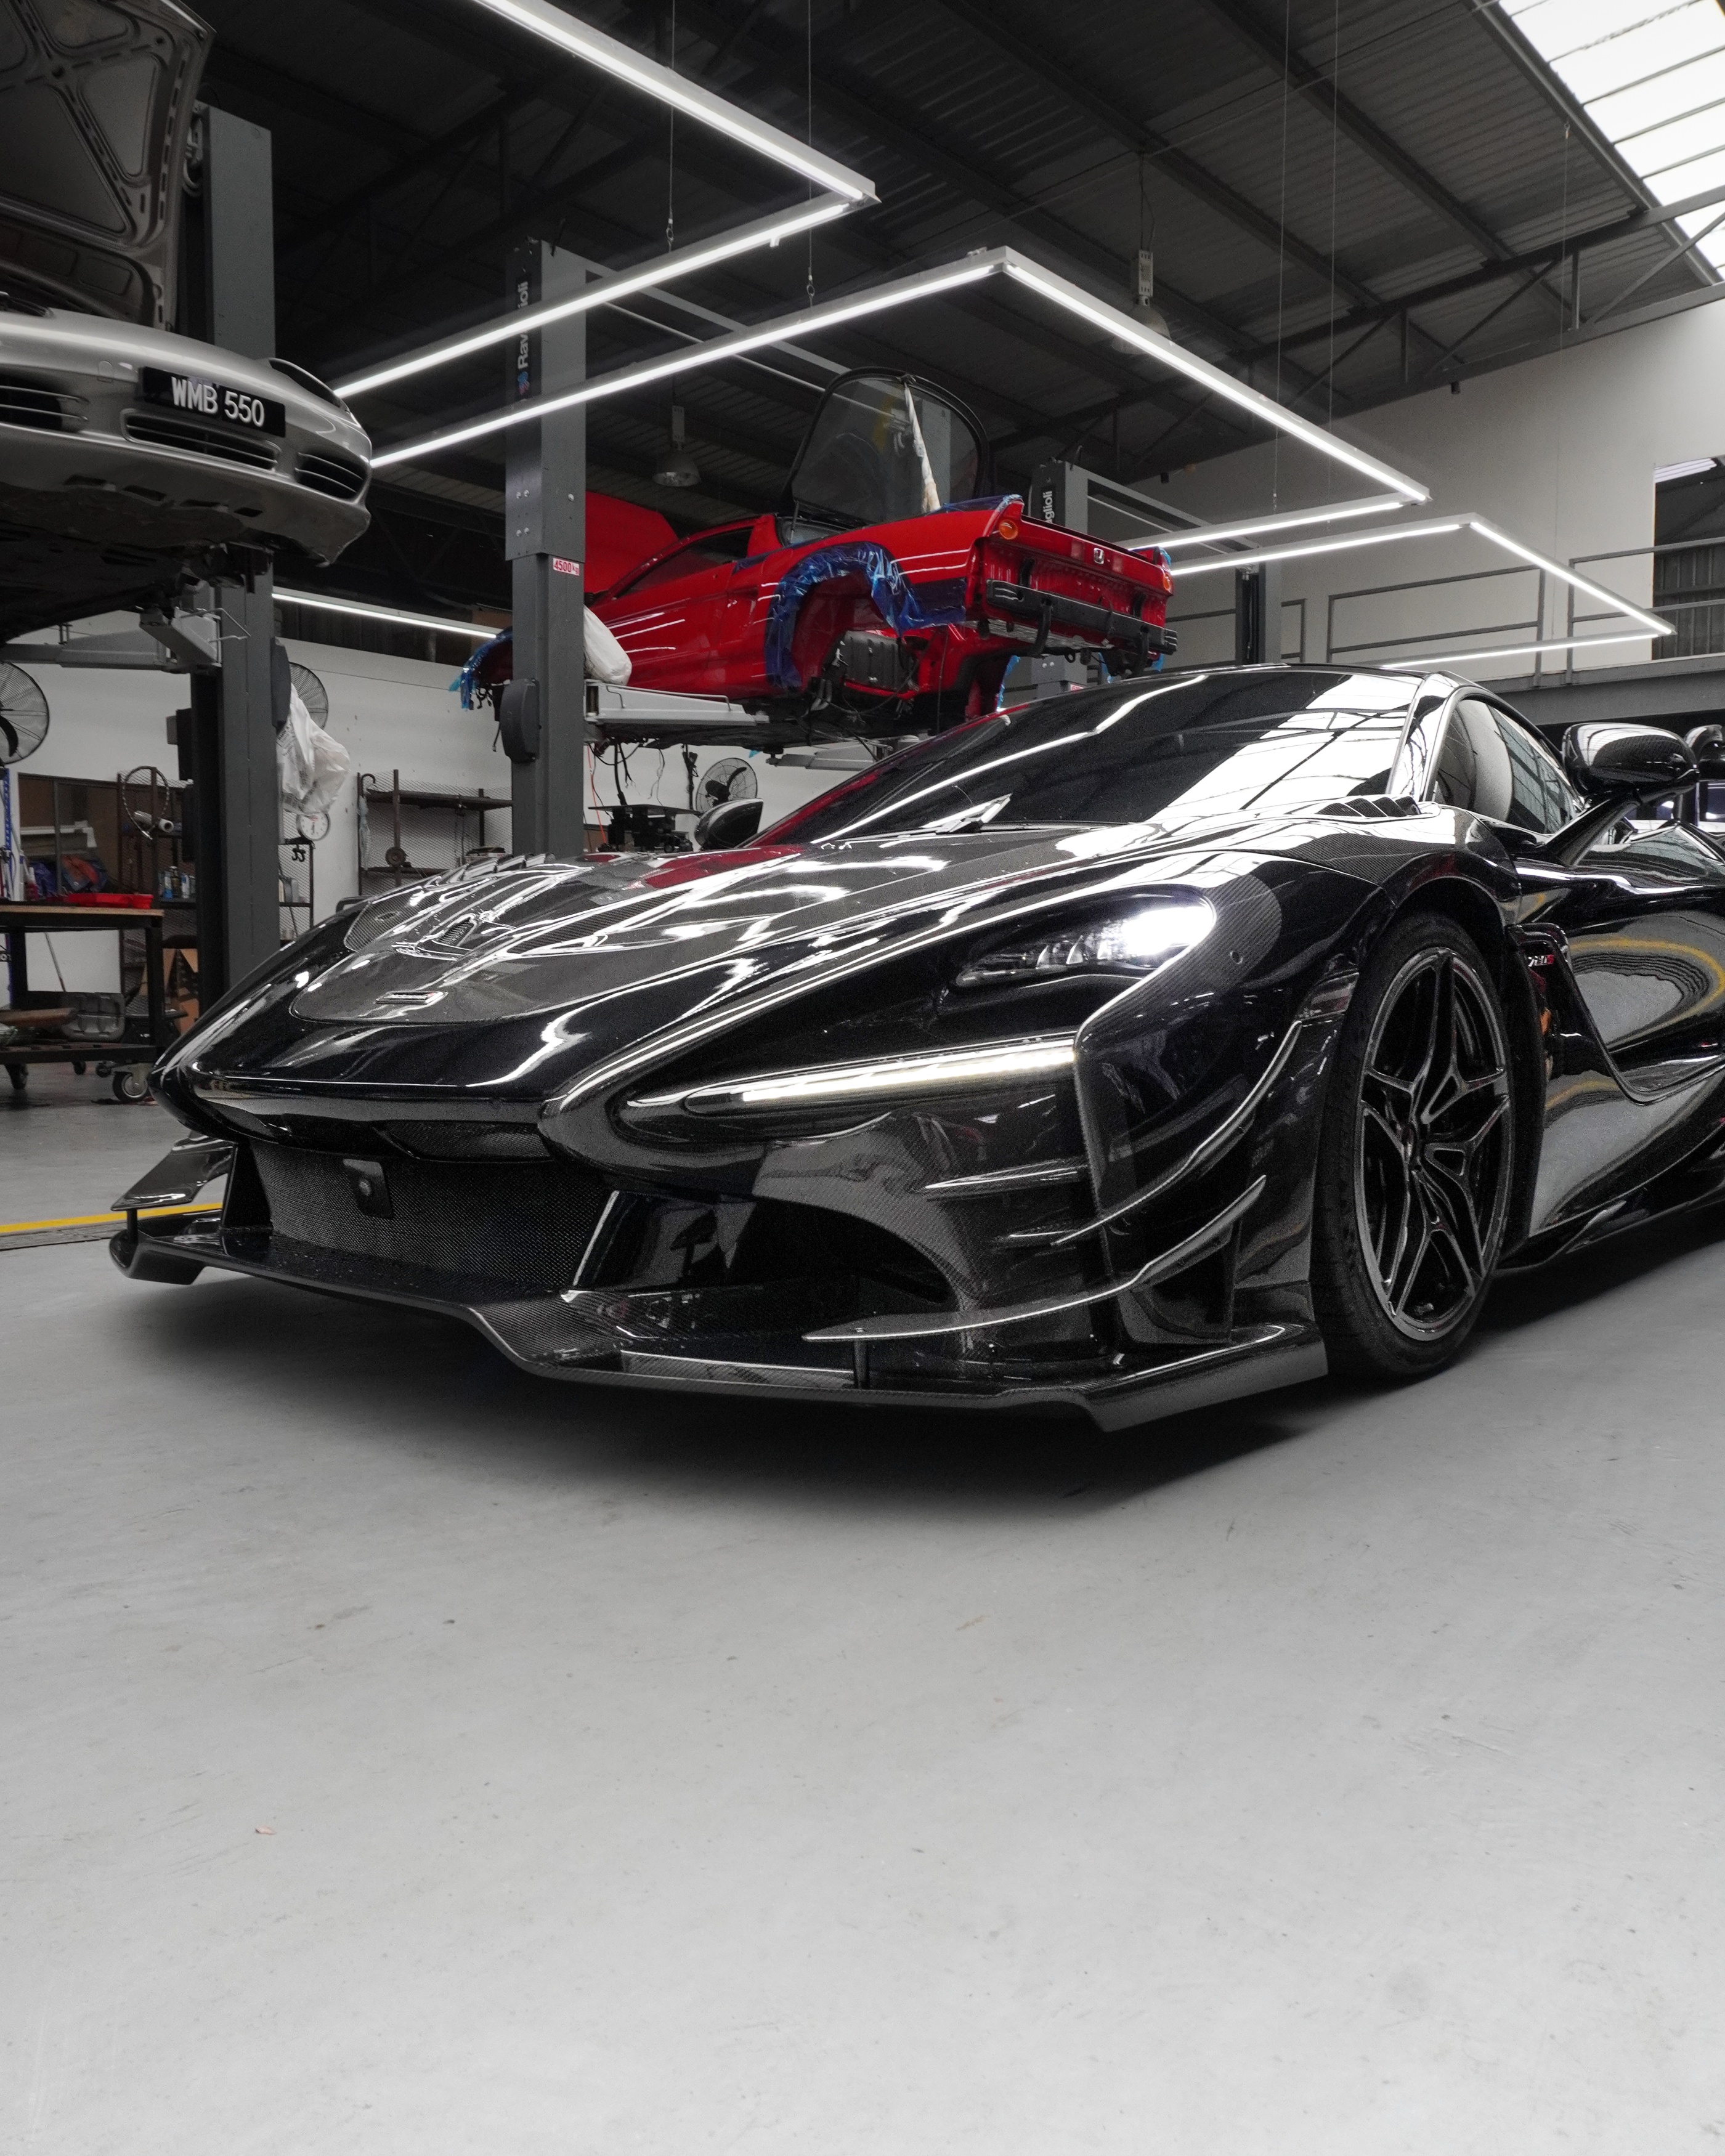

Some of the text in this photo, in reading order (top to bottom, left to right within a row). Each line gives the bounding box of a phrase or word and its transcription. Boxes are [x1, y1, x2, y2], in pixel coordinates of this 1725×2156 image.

[518, 281, 529, 370] Ravioli
[171, 376, 265, 428] WMB 550
